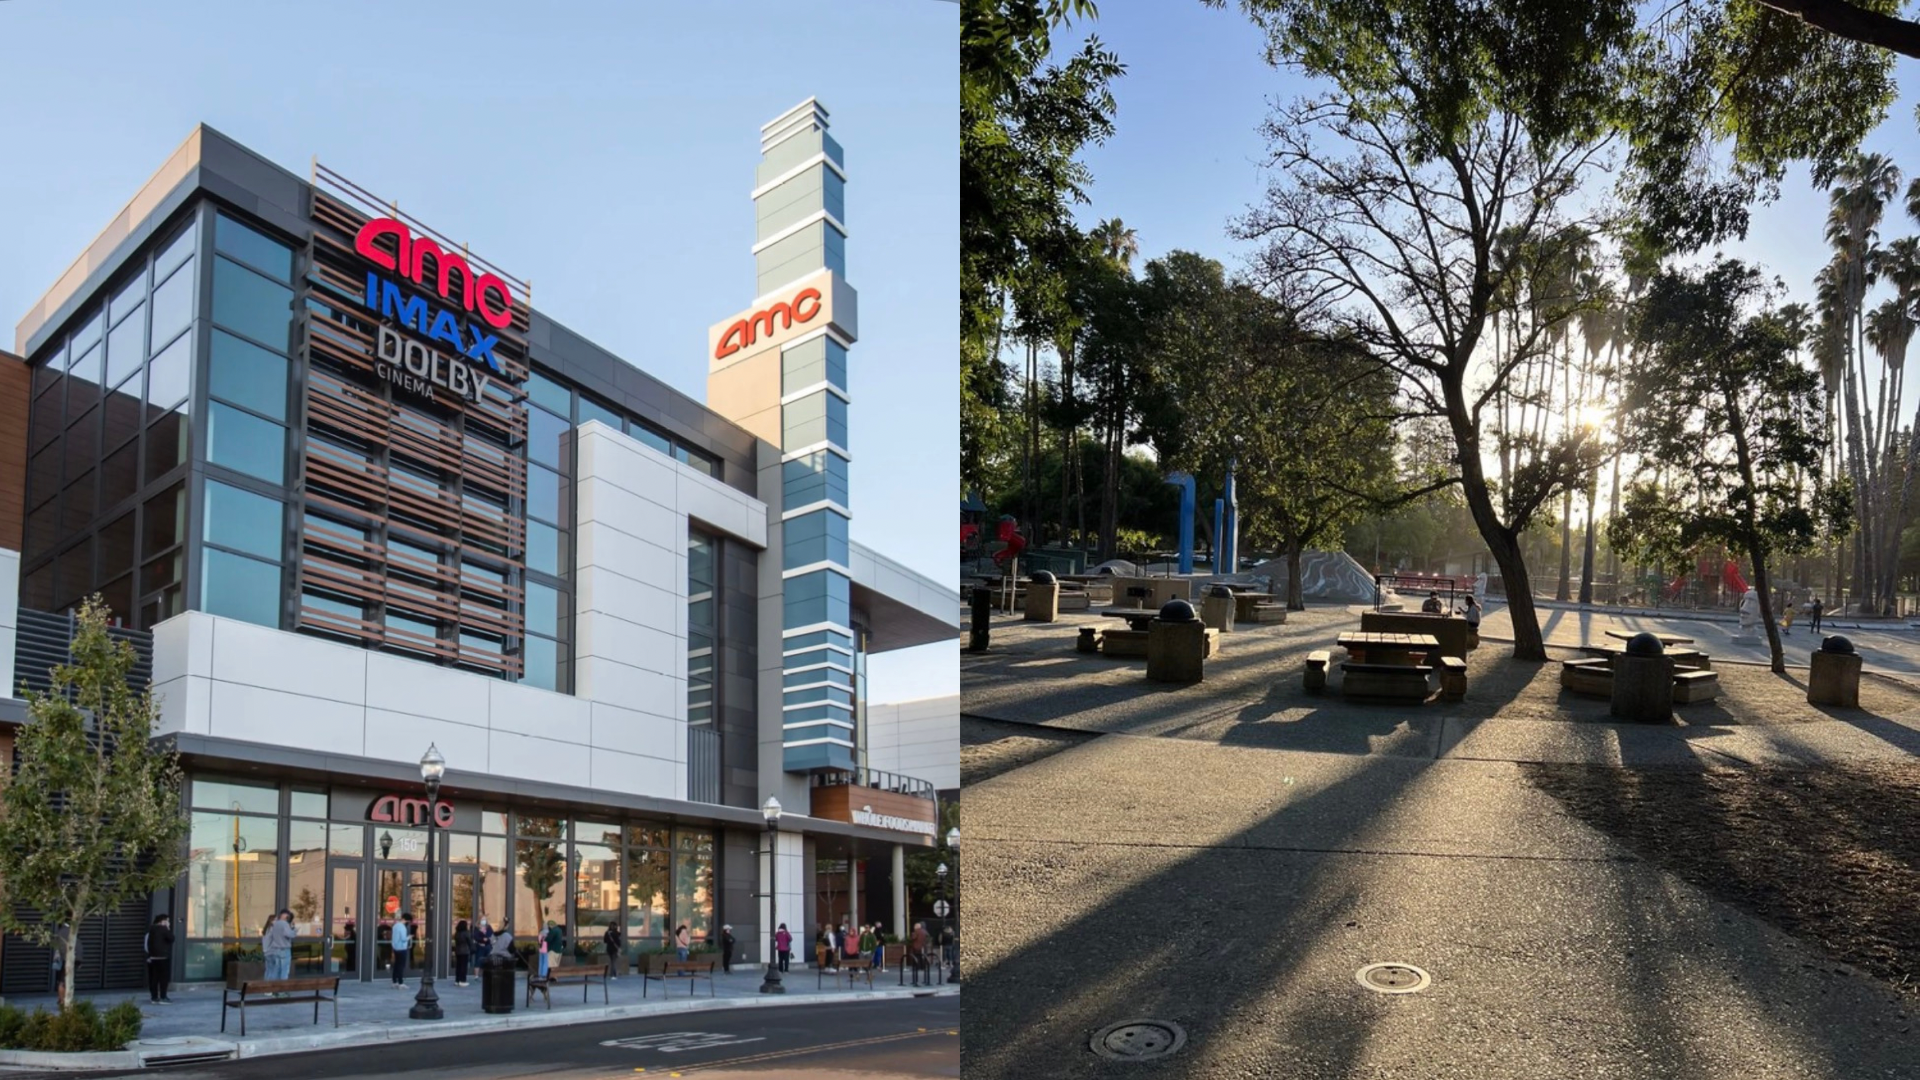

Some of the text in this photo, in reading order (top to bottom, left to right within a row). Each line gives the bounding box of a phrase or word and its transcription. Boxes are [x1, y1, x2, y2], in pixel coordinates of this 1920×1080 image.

[365, 270, 500, 371] IMAX
[377, 324, 489, 405] DOLBY
[377, 362, 434, 401] CINEMA
[399, 838, 417, 851] 150
